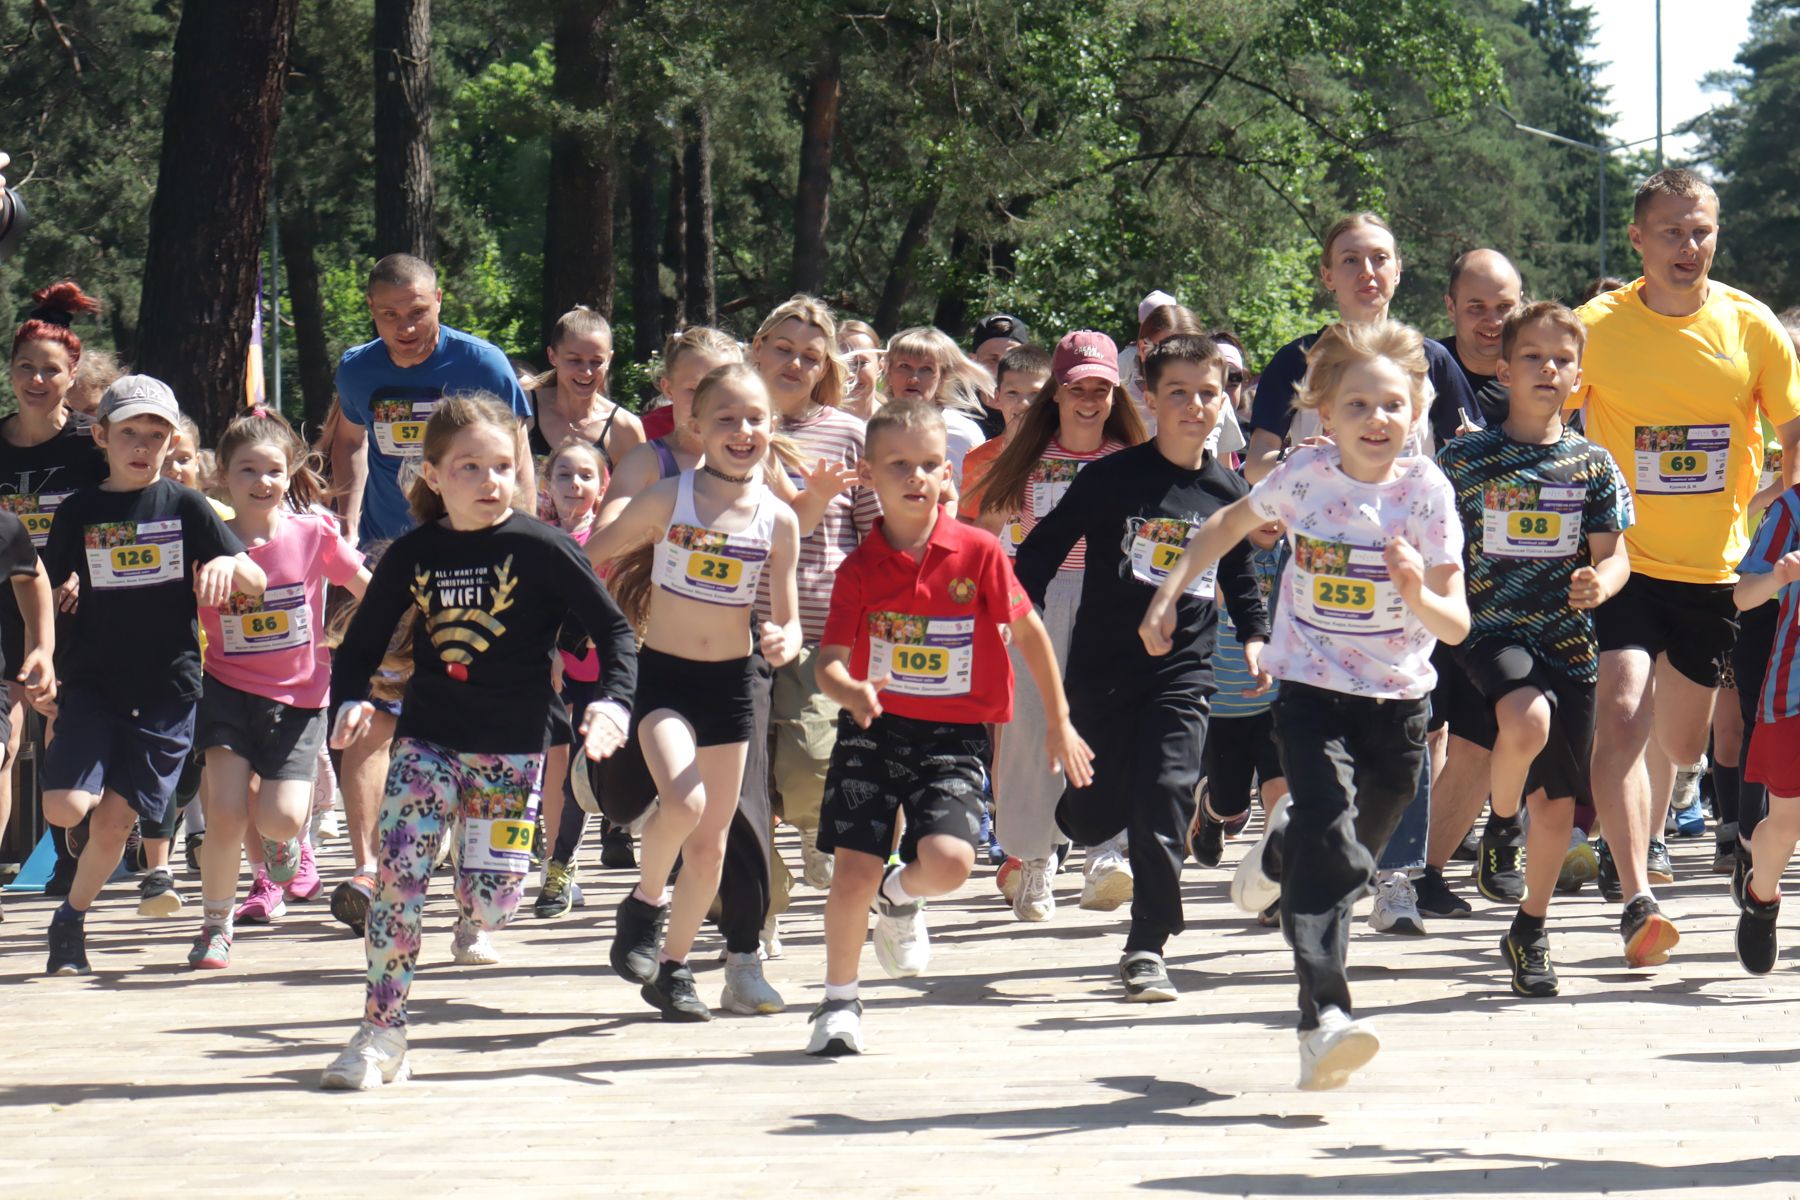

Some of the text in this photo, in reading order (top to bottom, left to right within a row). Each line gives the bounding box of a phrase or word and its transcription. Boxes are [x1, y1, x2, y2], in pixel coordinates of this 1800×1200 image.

[402, 426, 419, 439] 57
[1671, 456, 1697, 472] 69
[28, 517, 51, 531] 90
[1520, 517, 1549, 535] 98
[117, 549, 154, 567] 126
[435, 570, 447, 578] ALL
[454, 569, 474, 577] WANT
[475, 567, 488, 575] FOR
[701, 560, 730, 580] 23
[436, 578, 475, 588] CHRISTMAS
[440, 586, 482, 607] WIFI
[1319, 582, 1367, 606] 253
[252, 616, 277, 633] 86
[898, 651, 942, 671] 105
[507, 826, 530, 846] 79
